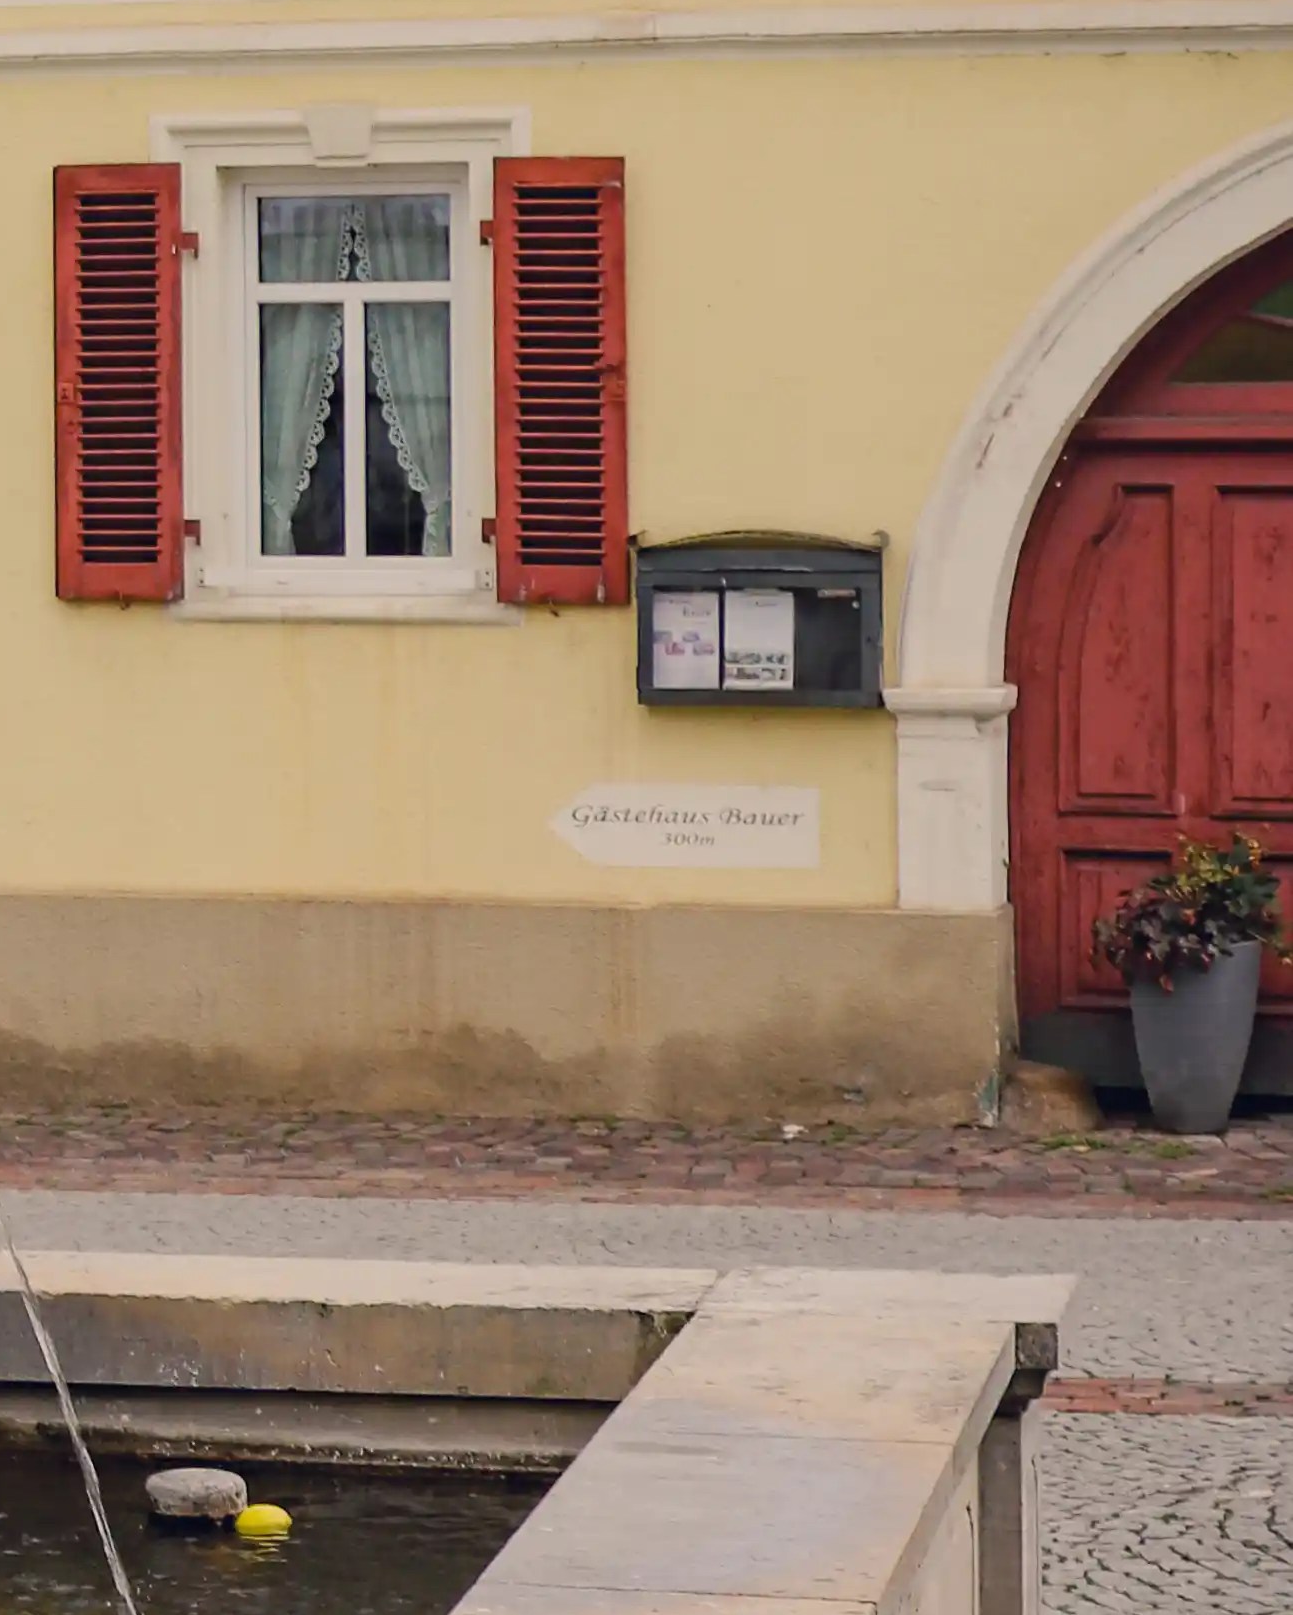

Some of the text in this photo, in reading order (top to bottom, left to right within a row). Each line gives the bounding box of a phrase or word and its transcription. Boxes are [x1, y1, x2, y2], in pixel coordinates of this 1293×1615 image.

[571, 803, 807, 828] Gästehaus Bauer
[661, 832, 716, 847] 300m
